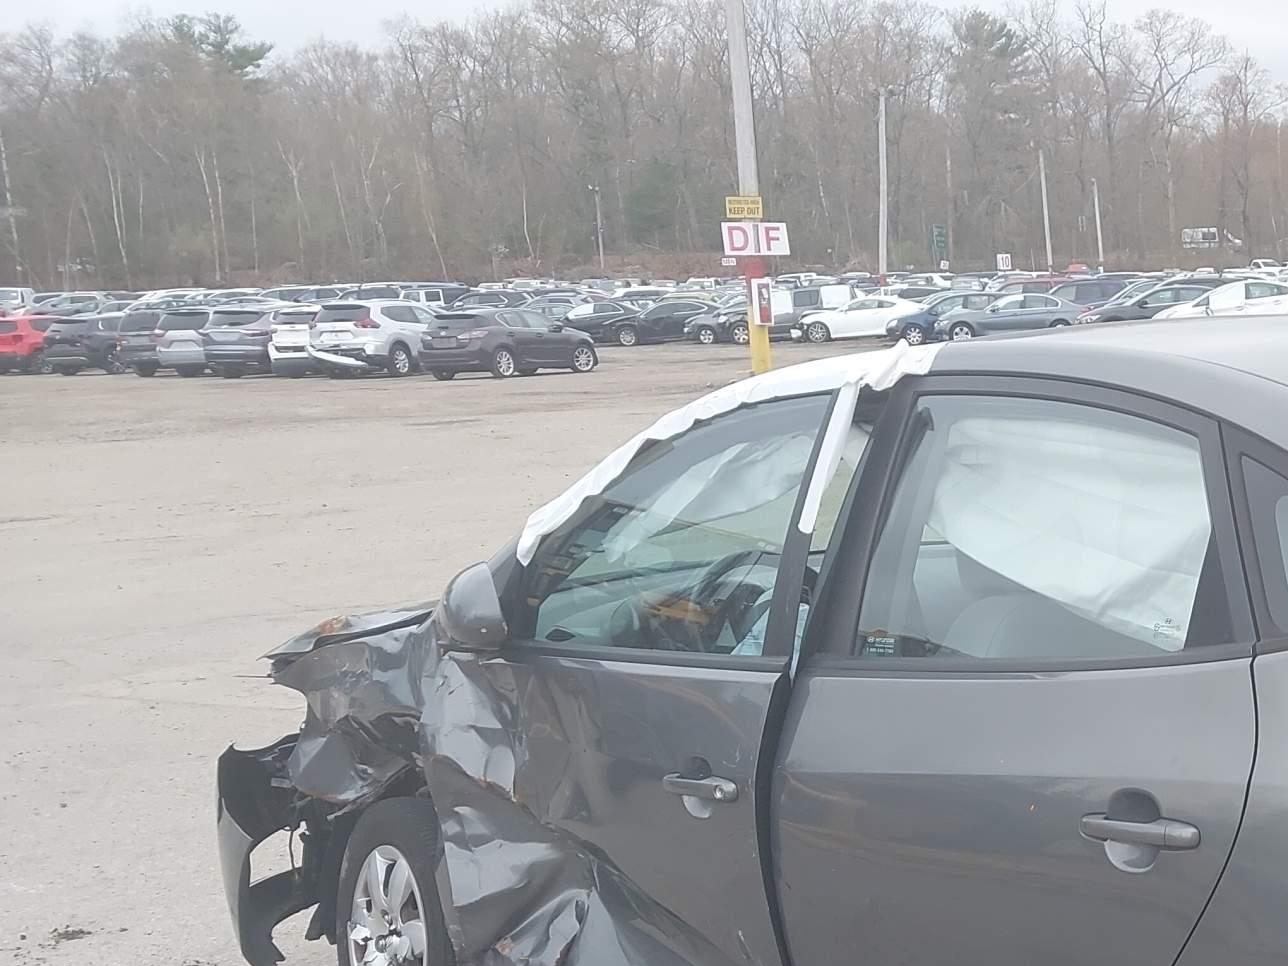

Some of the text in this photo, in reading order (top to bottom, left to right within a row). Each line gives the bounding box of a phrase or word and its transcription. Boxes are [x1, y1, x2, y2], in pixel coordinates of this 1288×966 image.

[728, 206, 760, 215] KEEP OUT
[727, 225, 780, 251] D F
